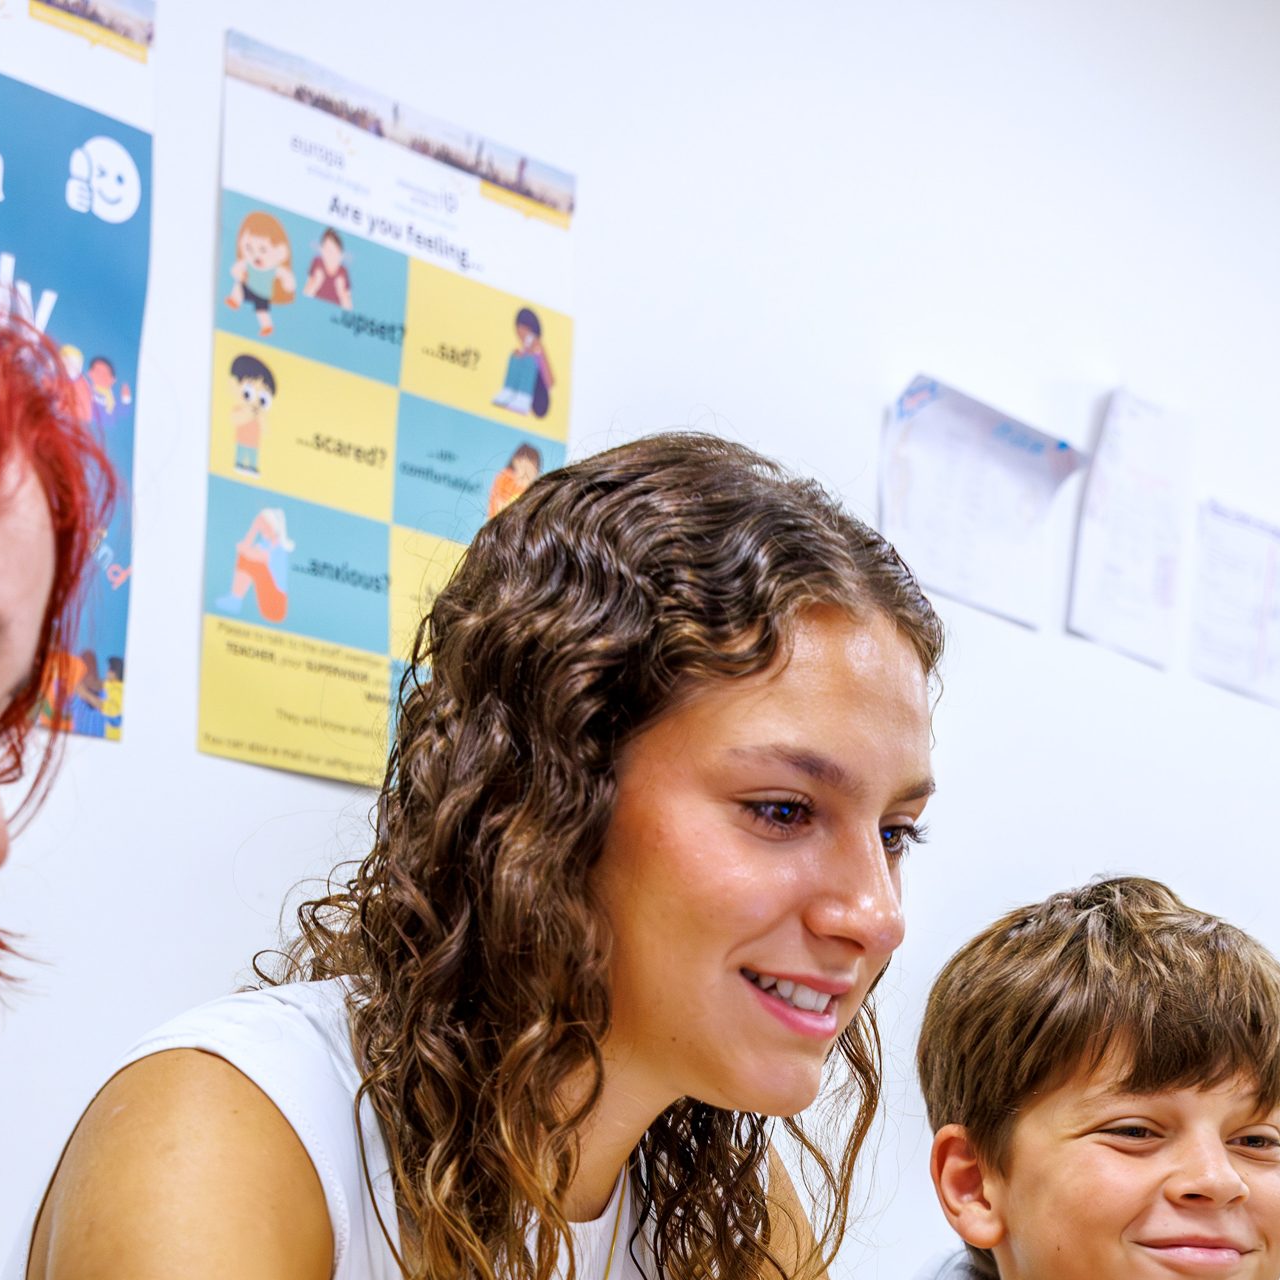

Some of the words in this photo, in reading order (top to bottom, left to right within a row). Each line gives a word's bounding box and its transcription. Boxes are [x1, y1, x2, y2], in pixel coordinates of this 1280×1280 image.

[328, 194, 363, 224] Are
[367, 214, 403, 241] you
[329, 310, 407, 348] ...upset?
[420, 342, 481, 372] ...sad?
[295, 432, 388, 470] ...scared?
